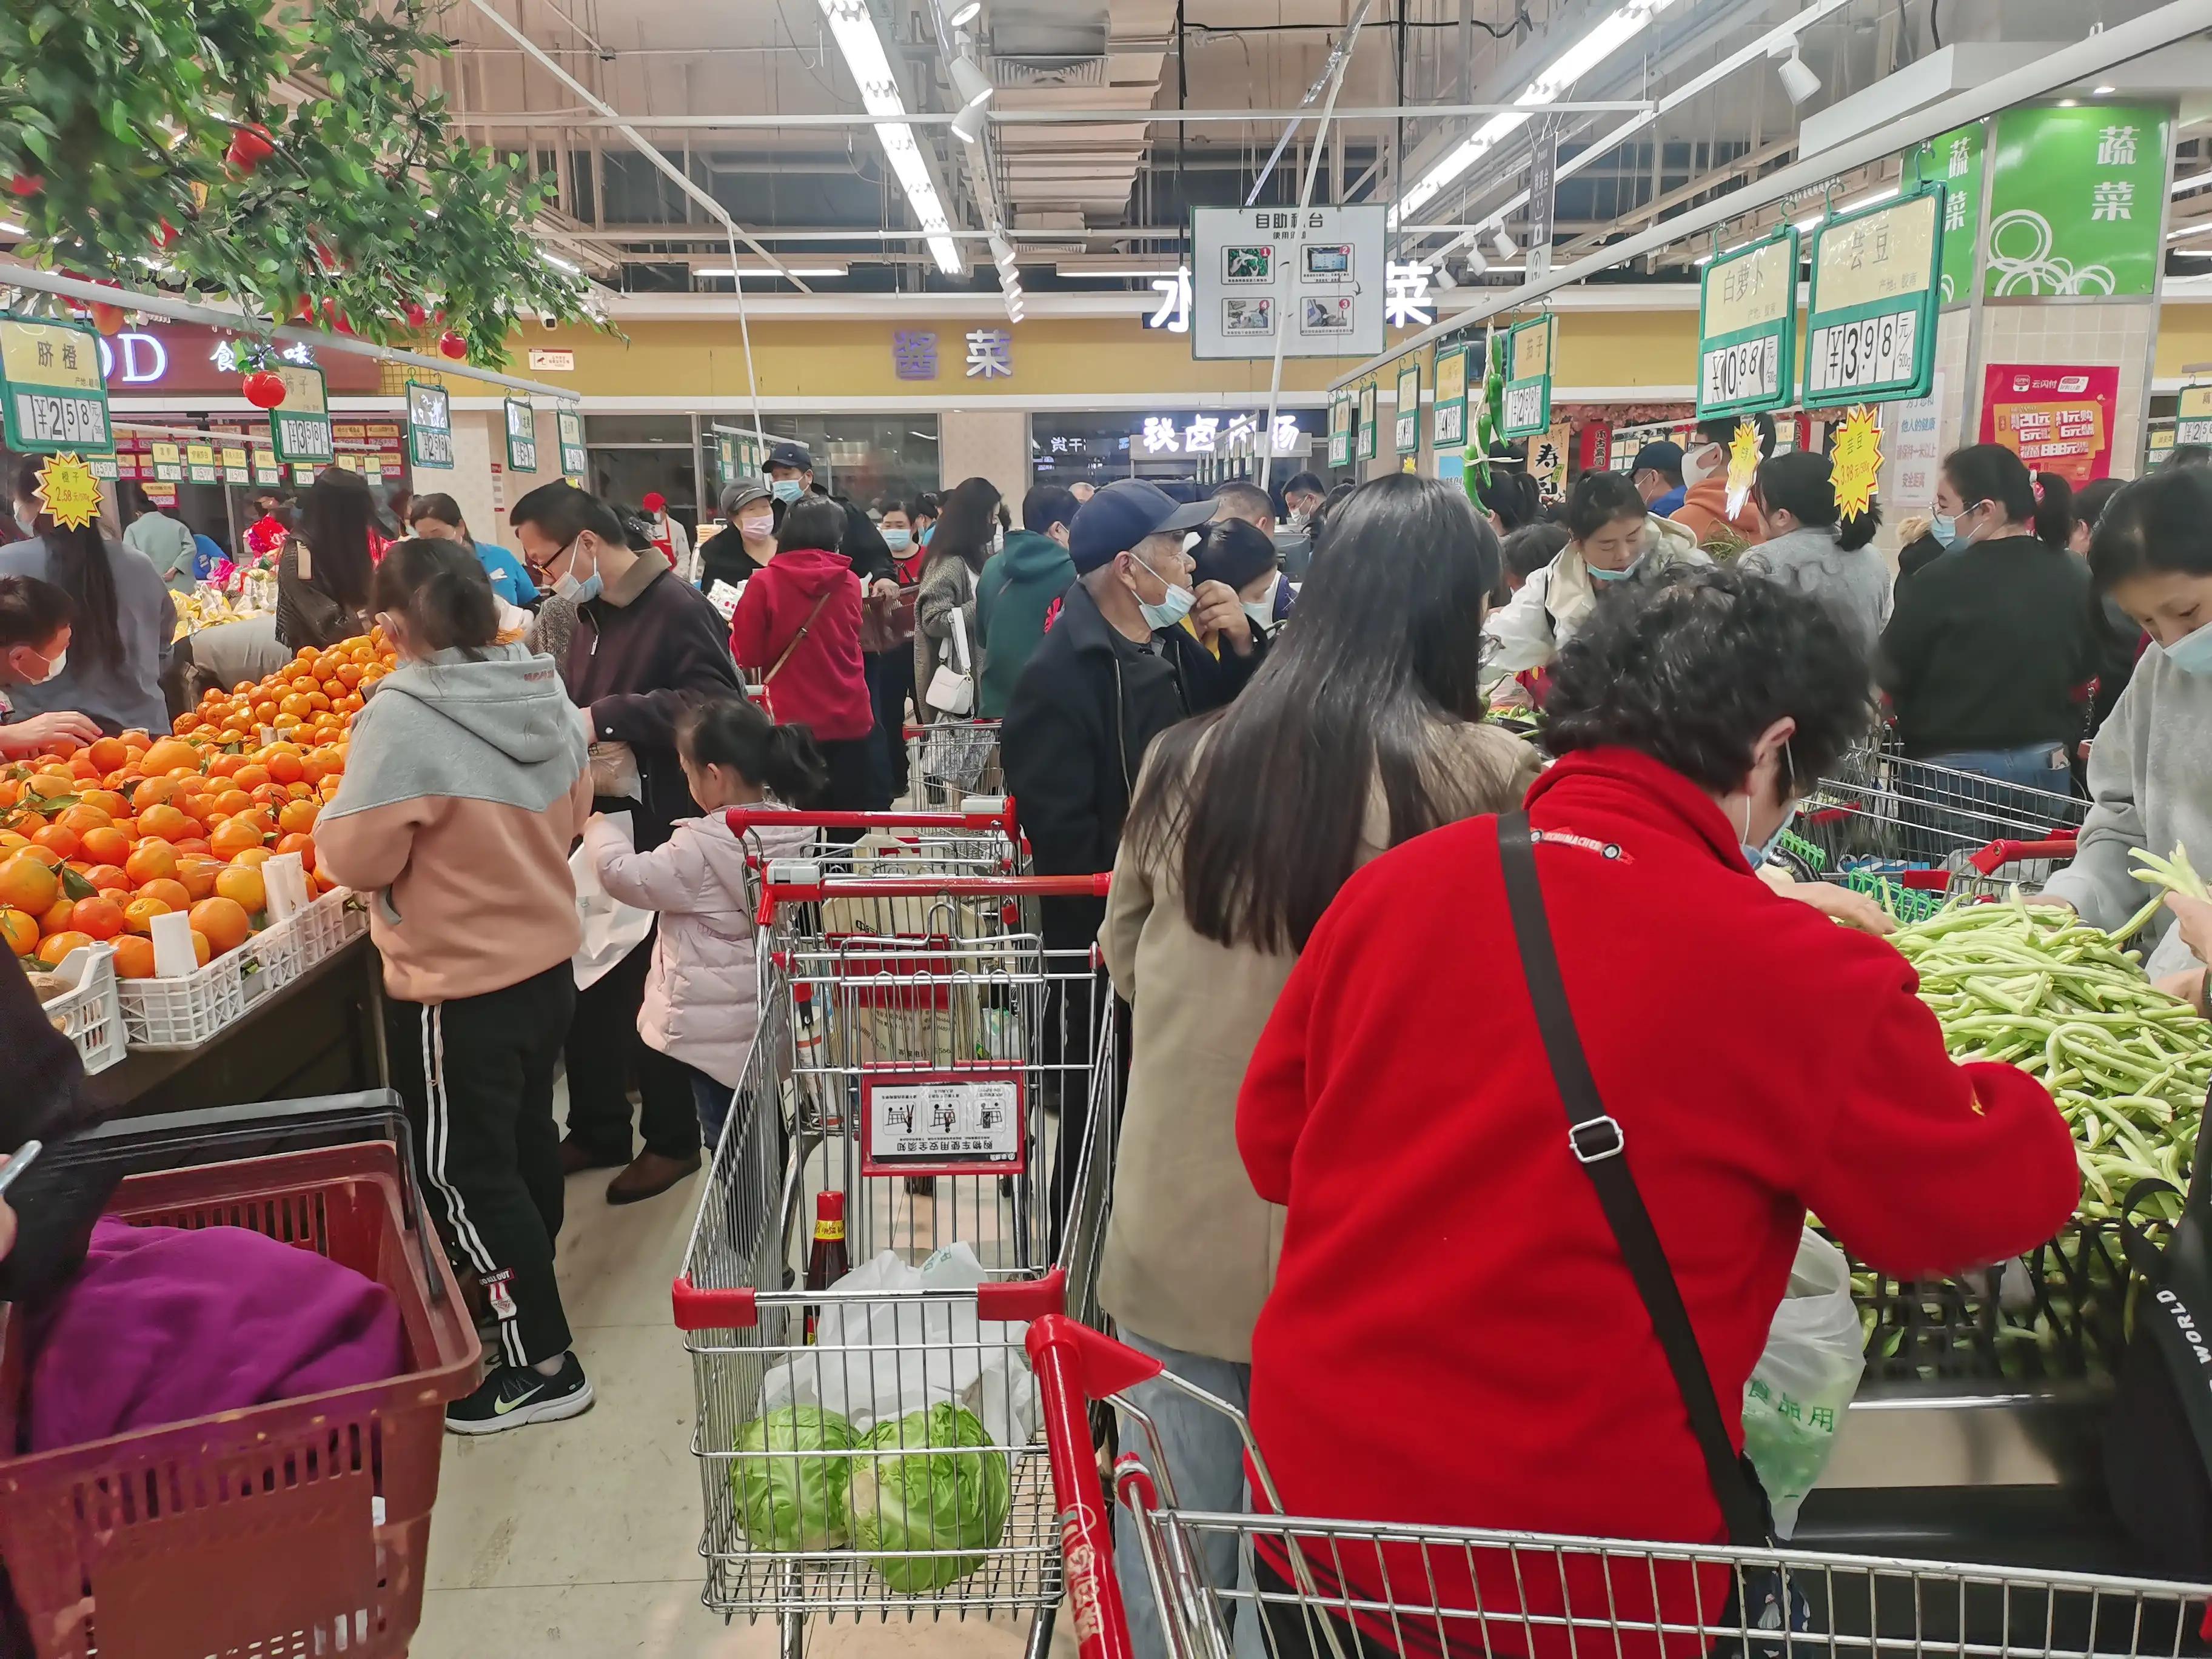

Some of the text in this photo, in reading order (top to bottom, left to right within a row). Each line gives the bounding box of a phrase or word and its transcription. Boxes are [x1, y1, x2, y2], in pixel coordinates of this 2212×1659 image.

[1945, 136, 1971, 232] 蔬菜
[2091, 126, 2140, 220] 蔬菜
[38, 341, 78, 370] 脐橙
[897, 1140, 993, 1151] 购物车使用安全须知
[2156, 1290, 2211, 1364] WORLD
